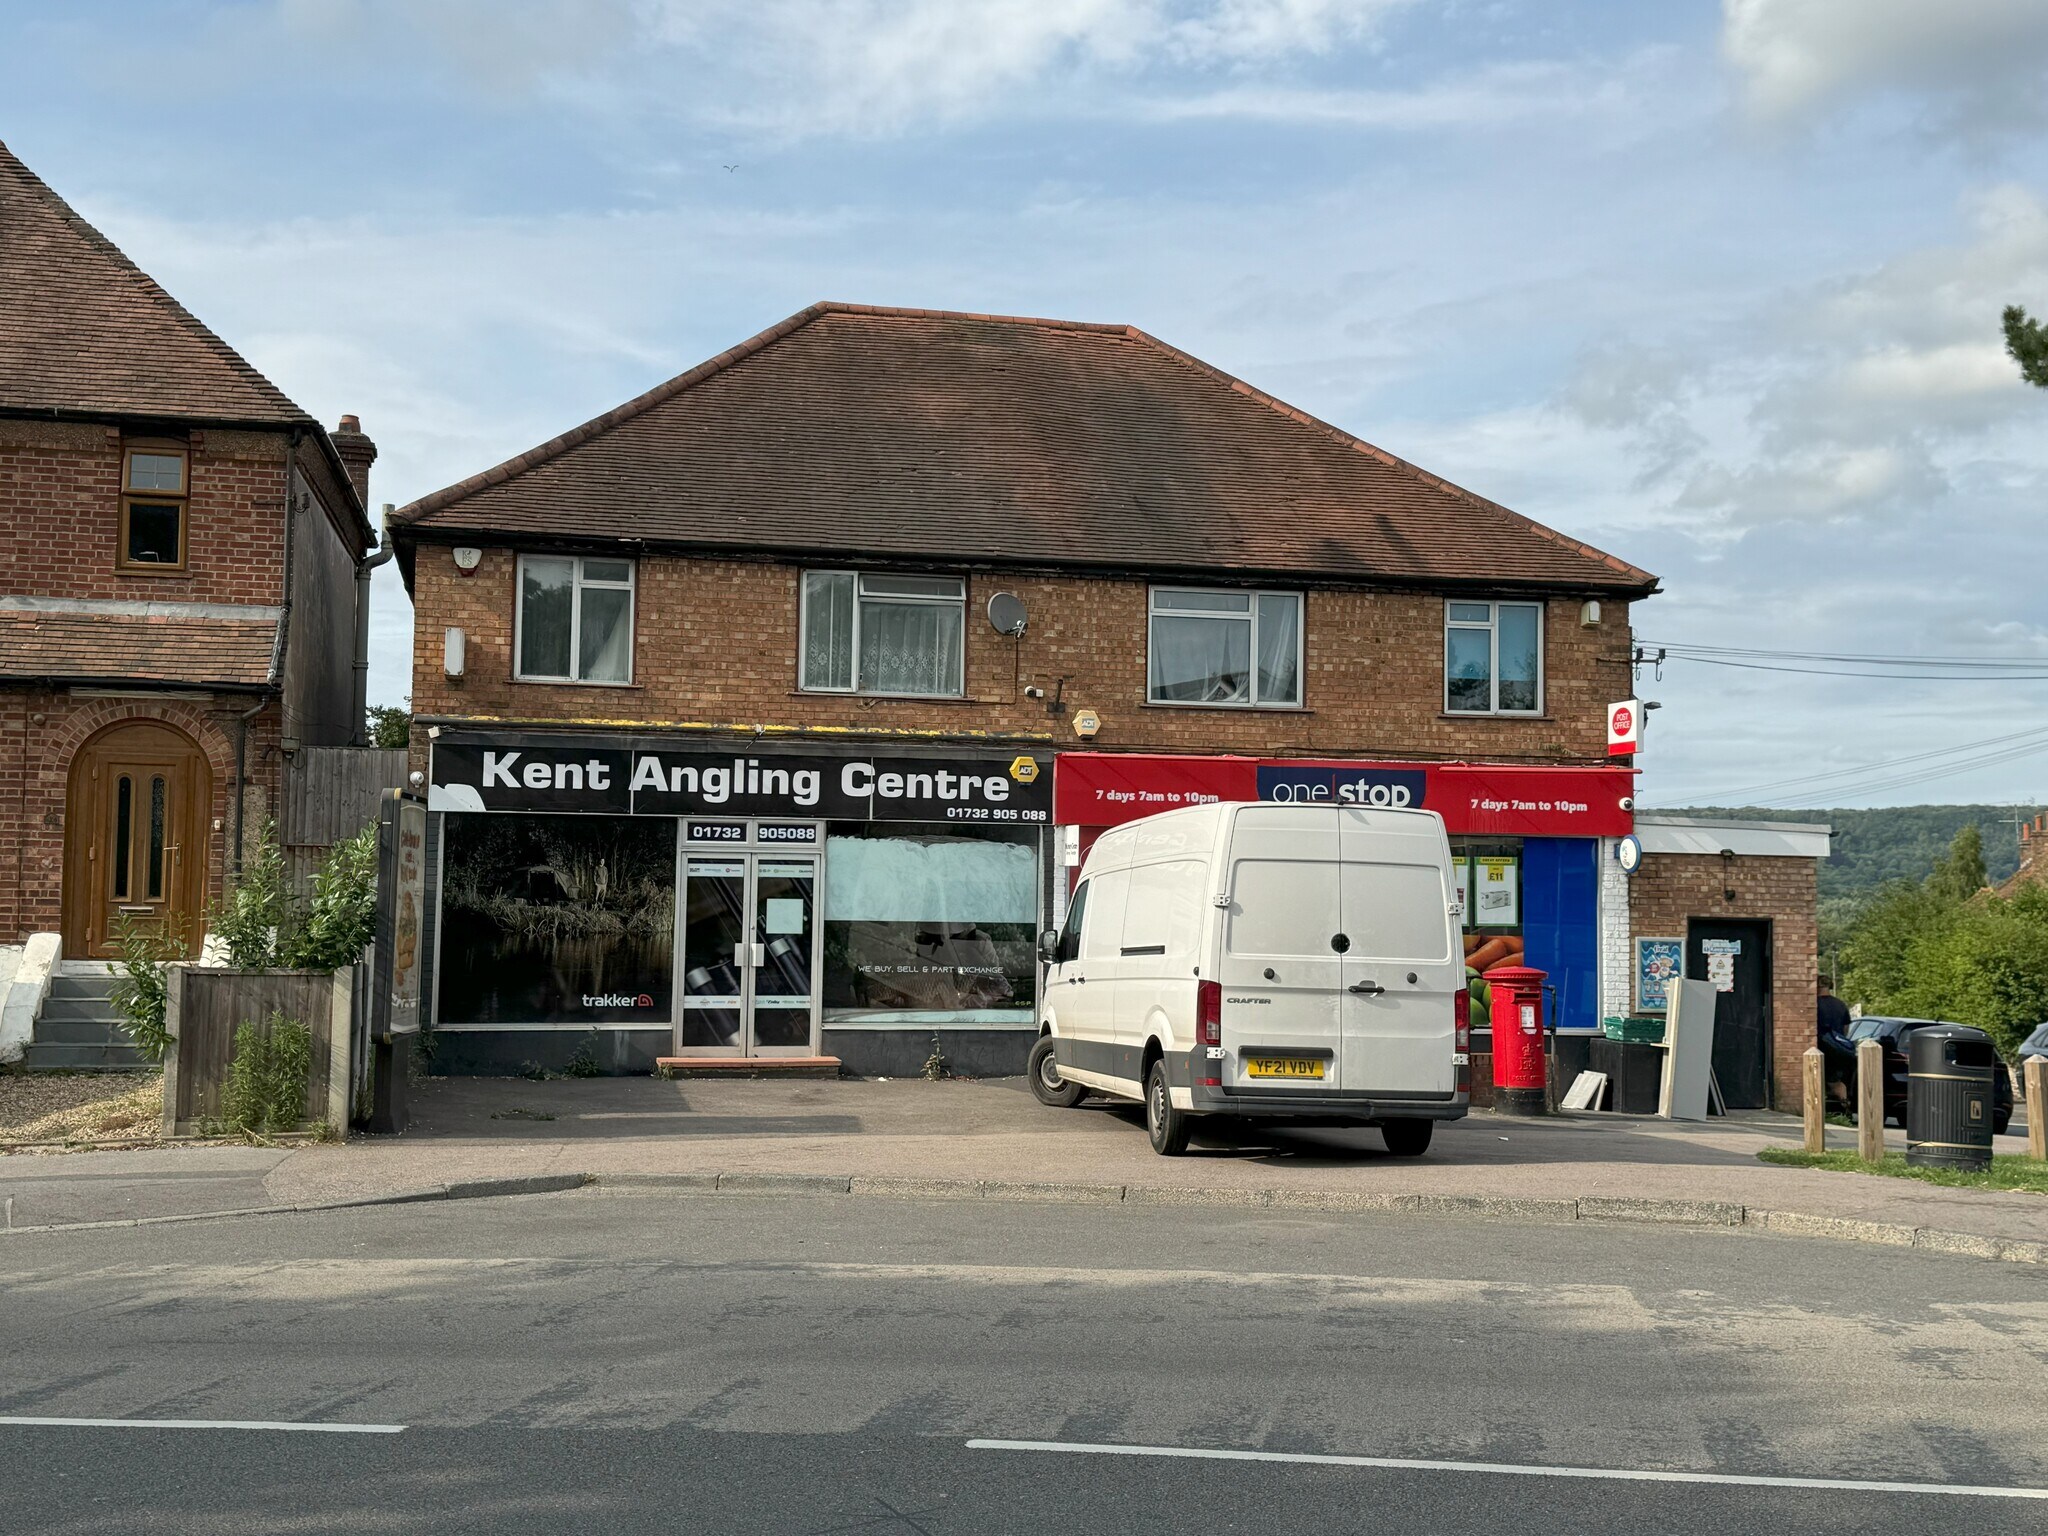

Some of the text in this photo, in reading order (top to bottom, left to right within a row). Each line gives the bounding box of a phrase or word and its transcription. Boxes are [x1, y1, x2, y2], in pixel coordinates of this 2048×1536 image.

[1616, 713, 1629, 721] POST
[1614, 721, 1631, 730] OFFICE
[1019, 766, 1032, 775] ADT
[482, 751, 1010, 806] Kent Angling Centre
[1096, 789, 1219, 805] 7 days 7am to 10pm
[1272, 778, 1411, 807] one stop
[1471, 799, 1588, 814] 7 days 7am to 10pm
[947, 807, 1047, 821] 01732 905 088
[693, 826, 815, 840] 01732 905088
[1489, 872, 1503, 881] £11
[957, 966, 1004, 974] EXCHANGE
[582, 993, 637, 1007] trakker
[1256, 1060, 1315, 1074] YF21 VDV
